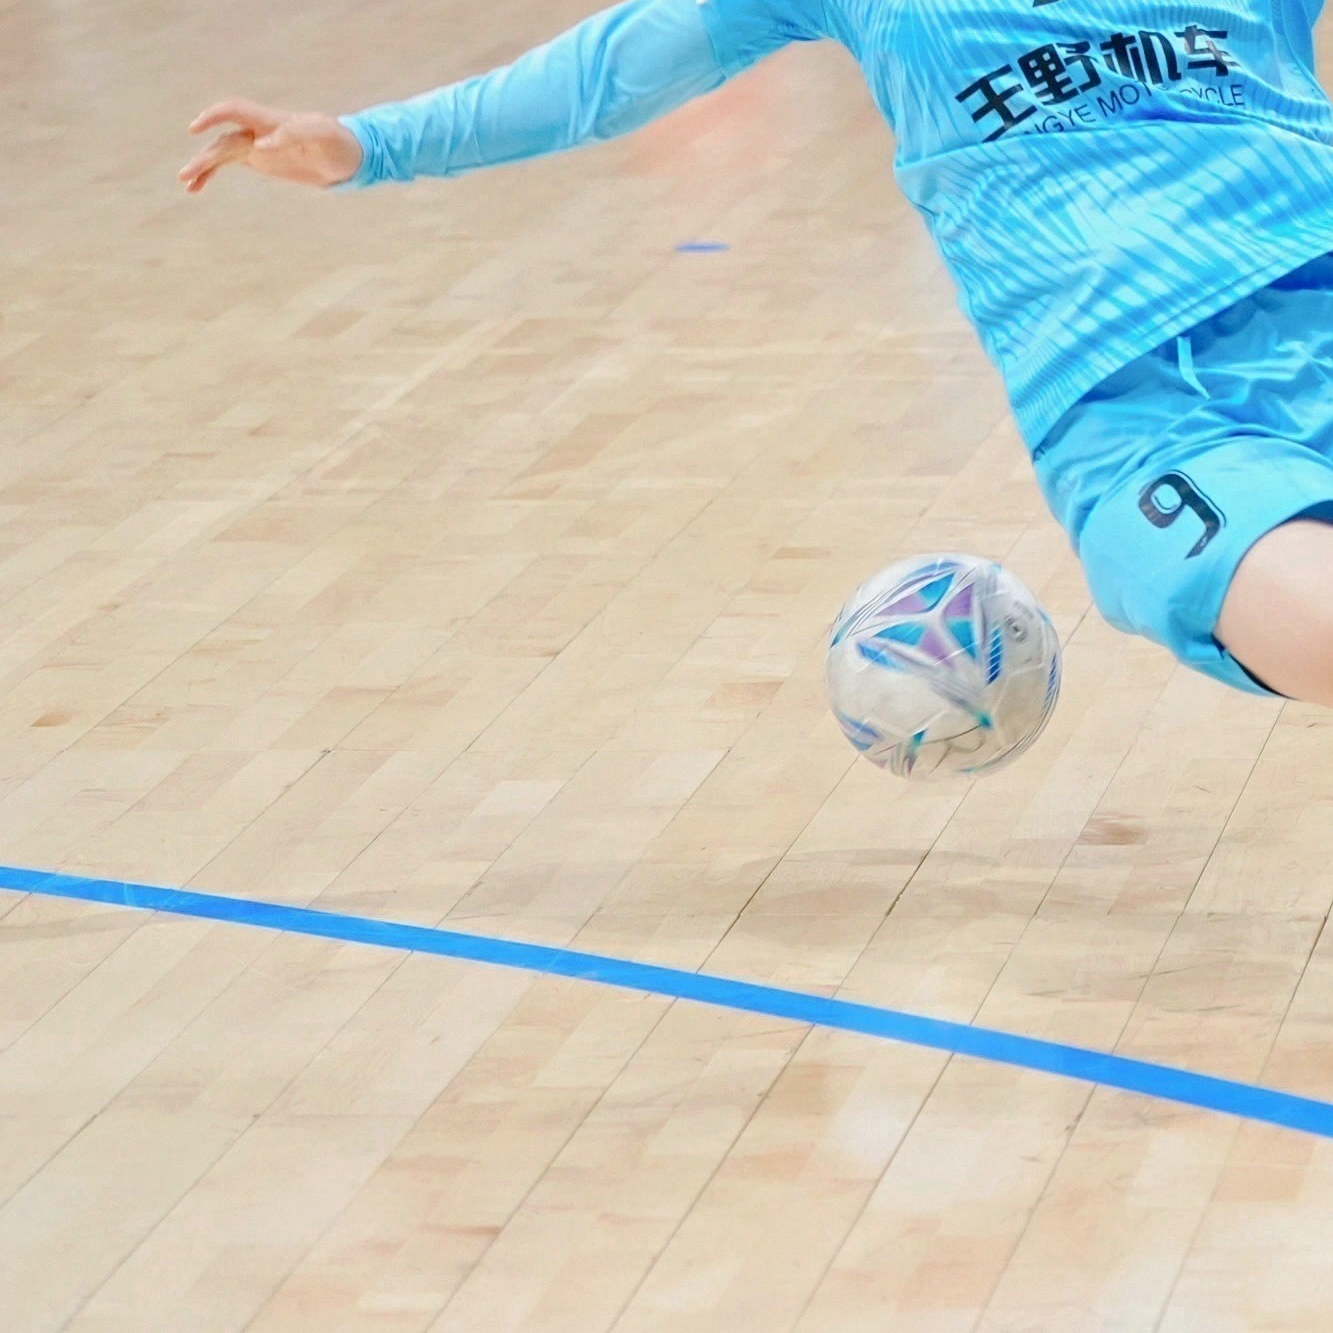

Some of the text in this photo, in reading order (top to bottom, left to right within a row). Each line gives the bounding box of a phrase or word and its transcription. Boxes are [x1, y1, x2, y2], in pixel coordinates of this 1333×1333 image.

[954, 24, 1242, 144] 王野机车
[1023, 82, 1246, 135] GYE MOYCLE
[1137, 469, 1227, 560] 9
